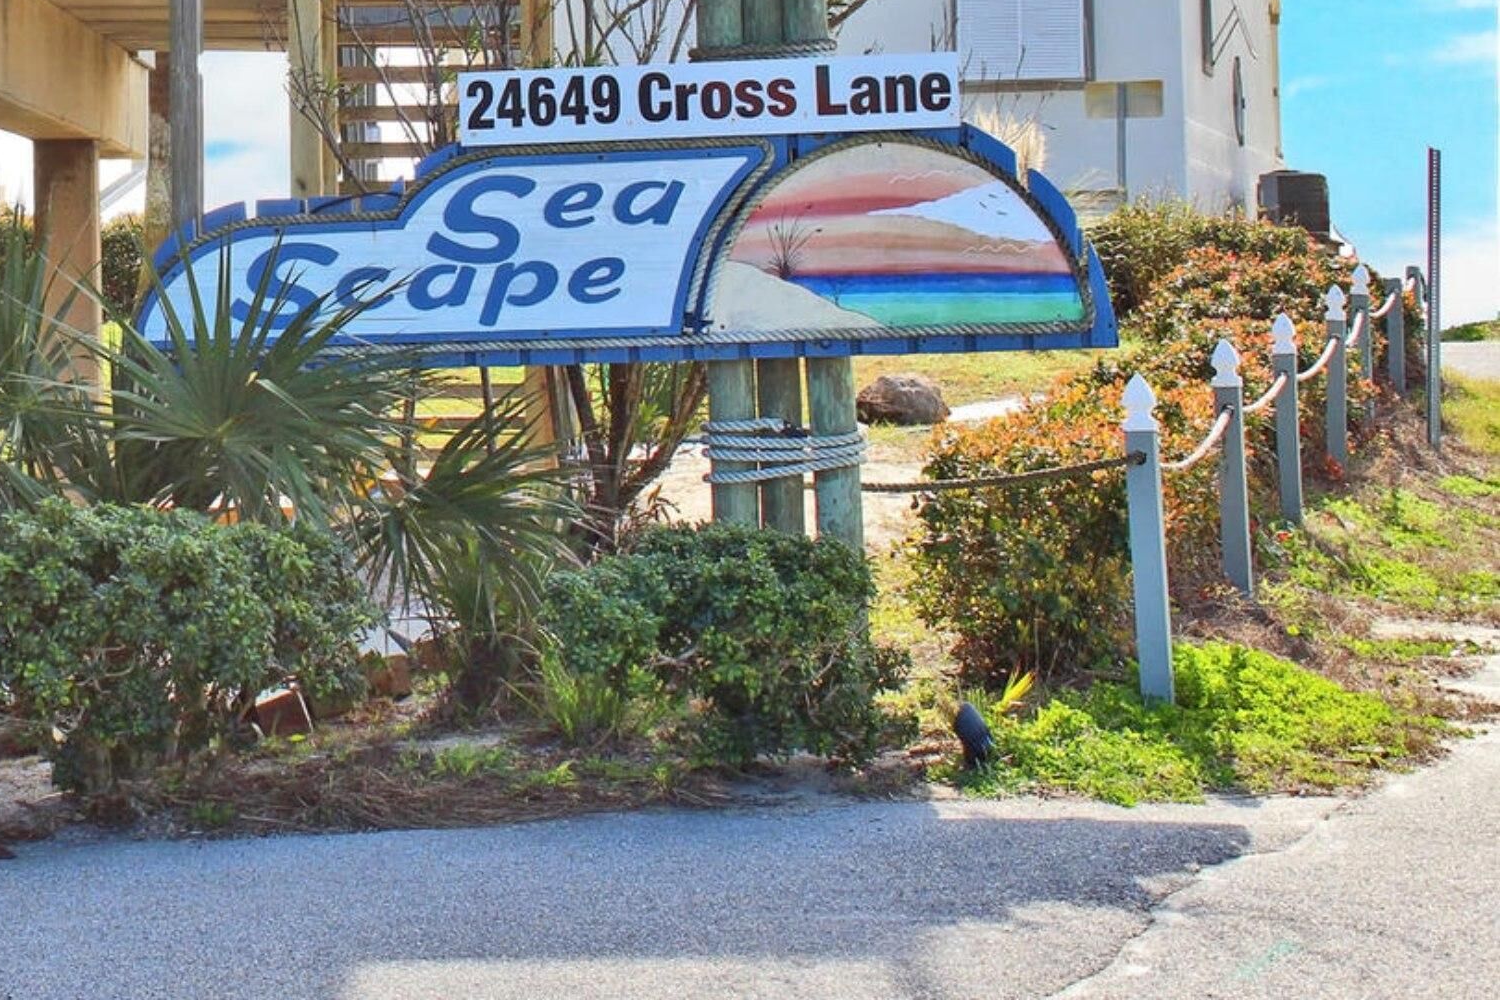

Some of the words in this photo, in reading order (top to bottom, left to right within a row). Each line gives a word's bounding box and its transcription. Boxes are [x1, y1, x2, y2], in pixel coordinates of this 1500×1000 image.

[466, 73, 621, 131] 24649
[638, 71, 797, 123] Cross
[815, 64, 951, 116] Lane
[426, 174, 686, 264] Sea
[231, 241, 626, 330] Scape
